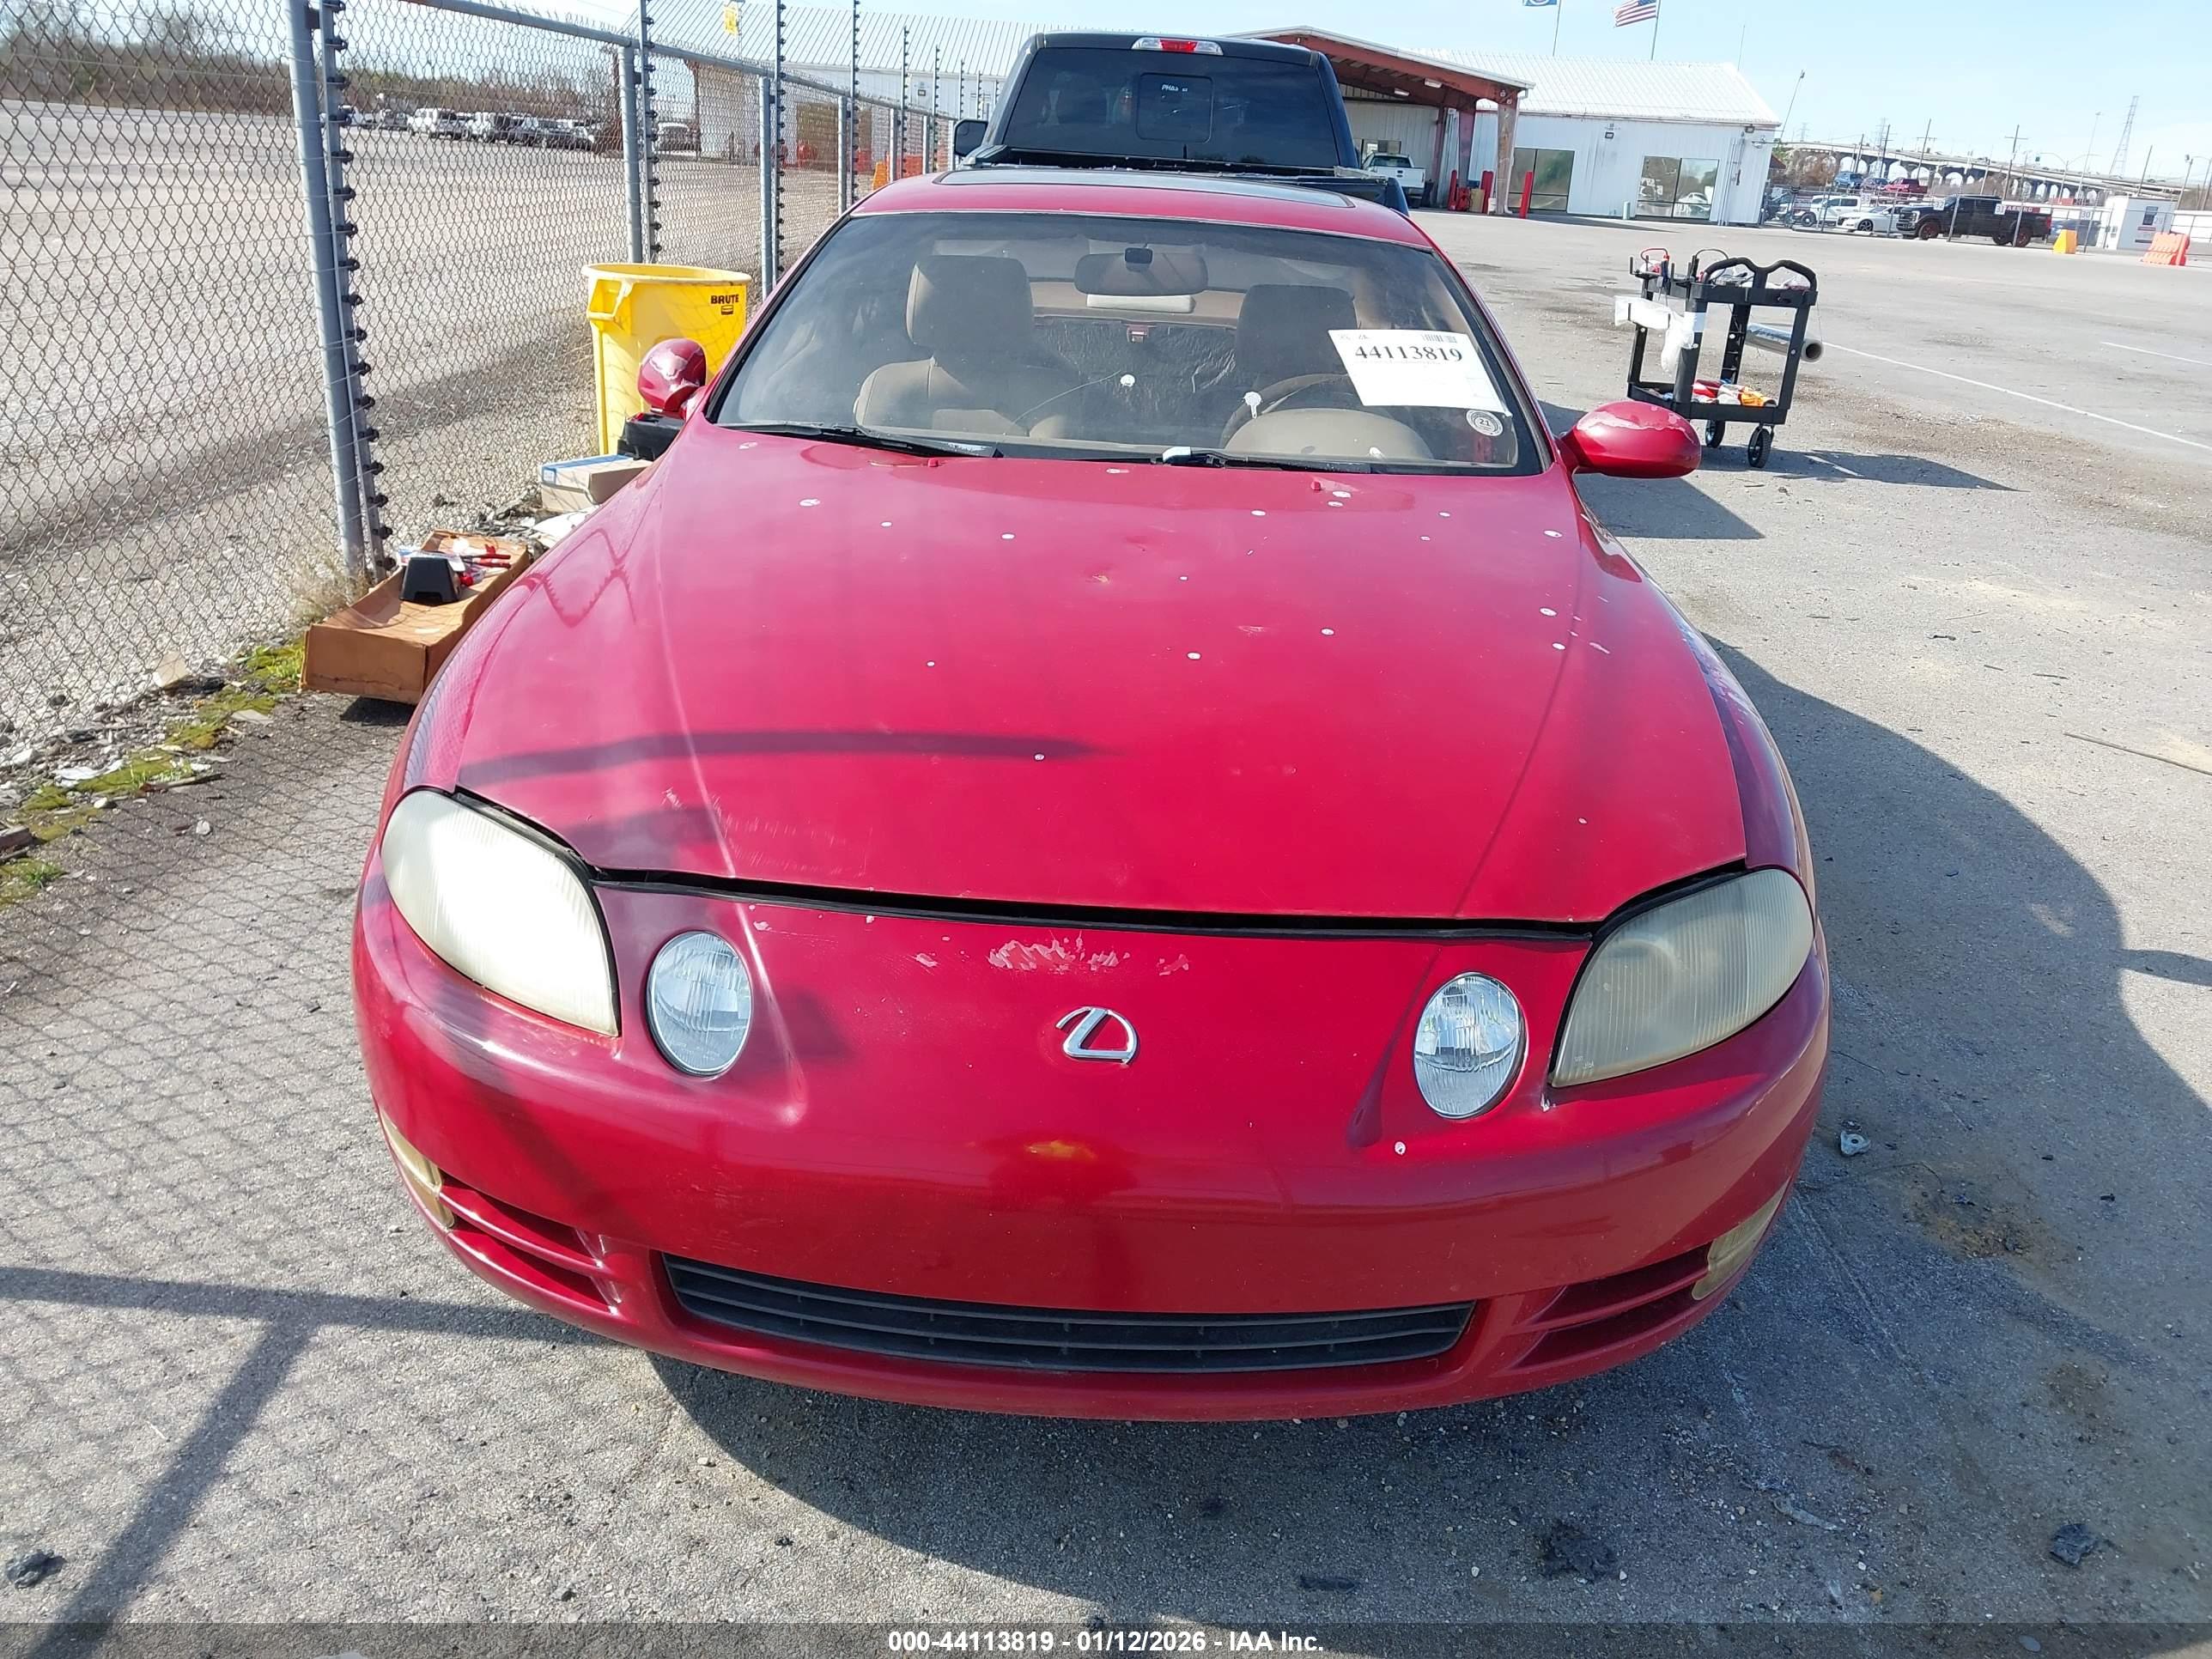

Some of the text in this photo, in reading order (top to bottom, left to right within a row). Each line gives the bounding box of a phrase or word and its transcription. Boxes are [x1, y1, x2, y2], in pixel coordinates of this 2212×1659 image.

[2081, 210, 2090, 219] 30
[710, 294, 739, 304] BRUTE
[1355, 345, 1462, 362] 44113819
